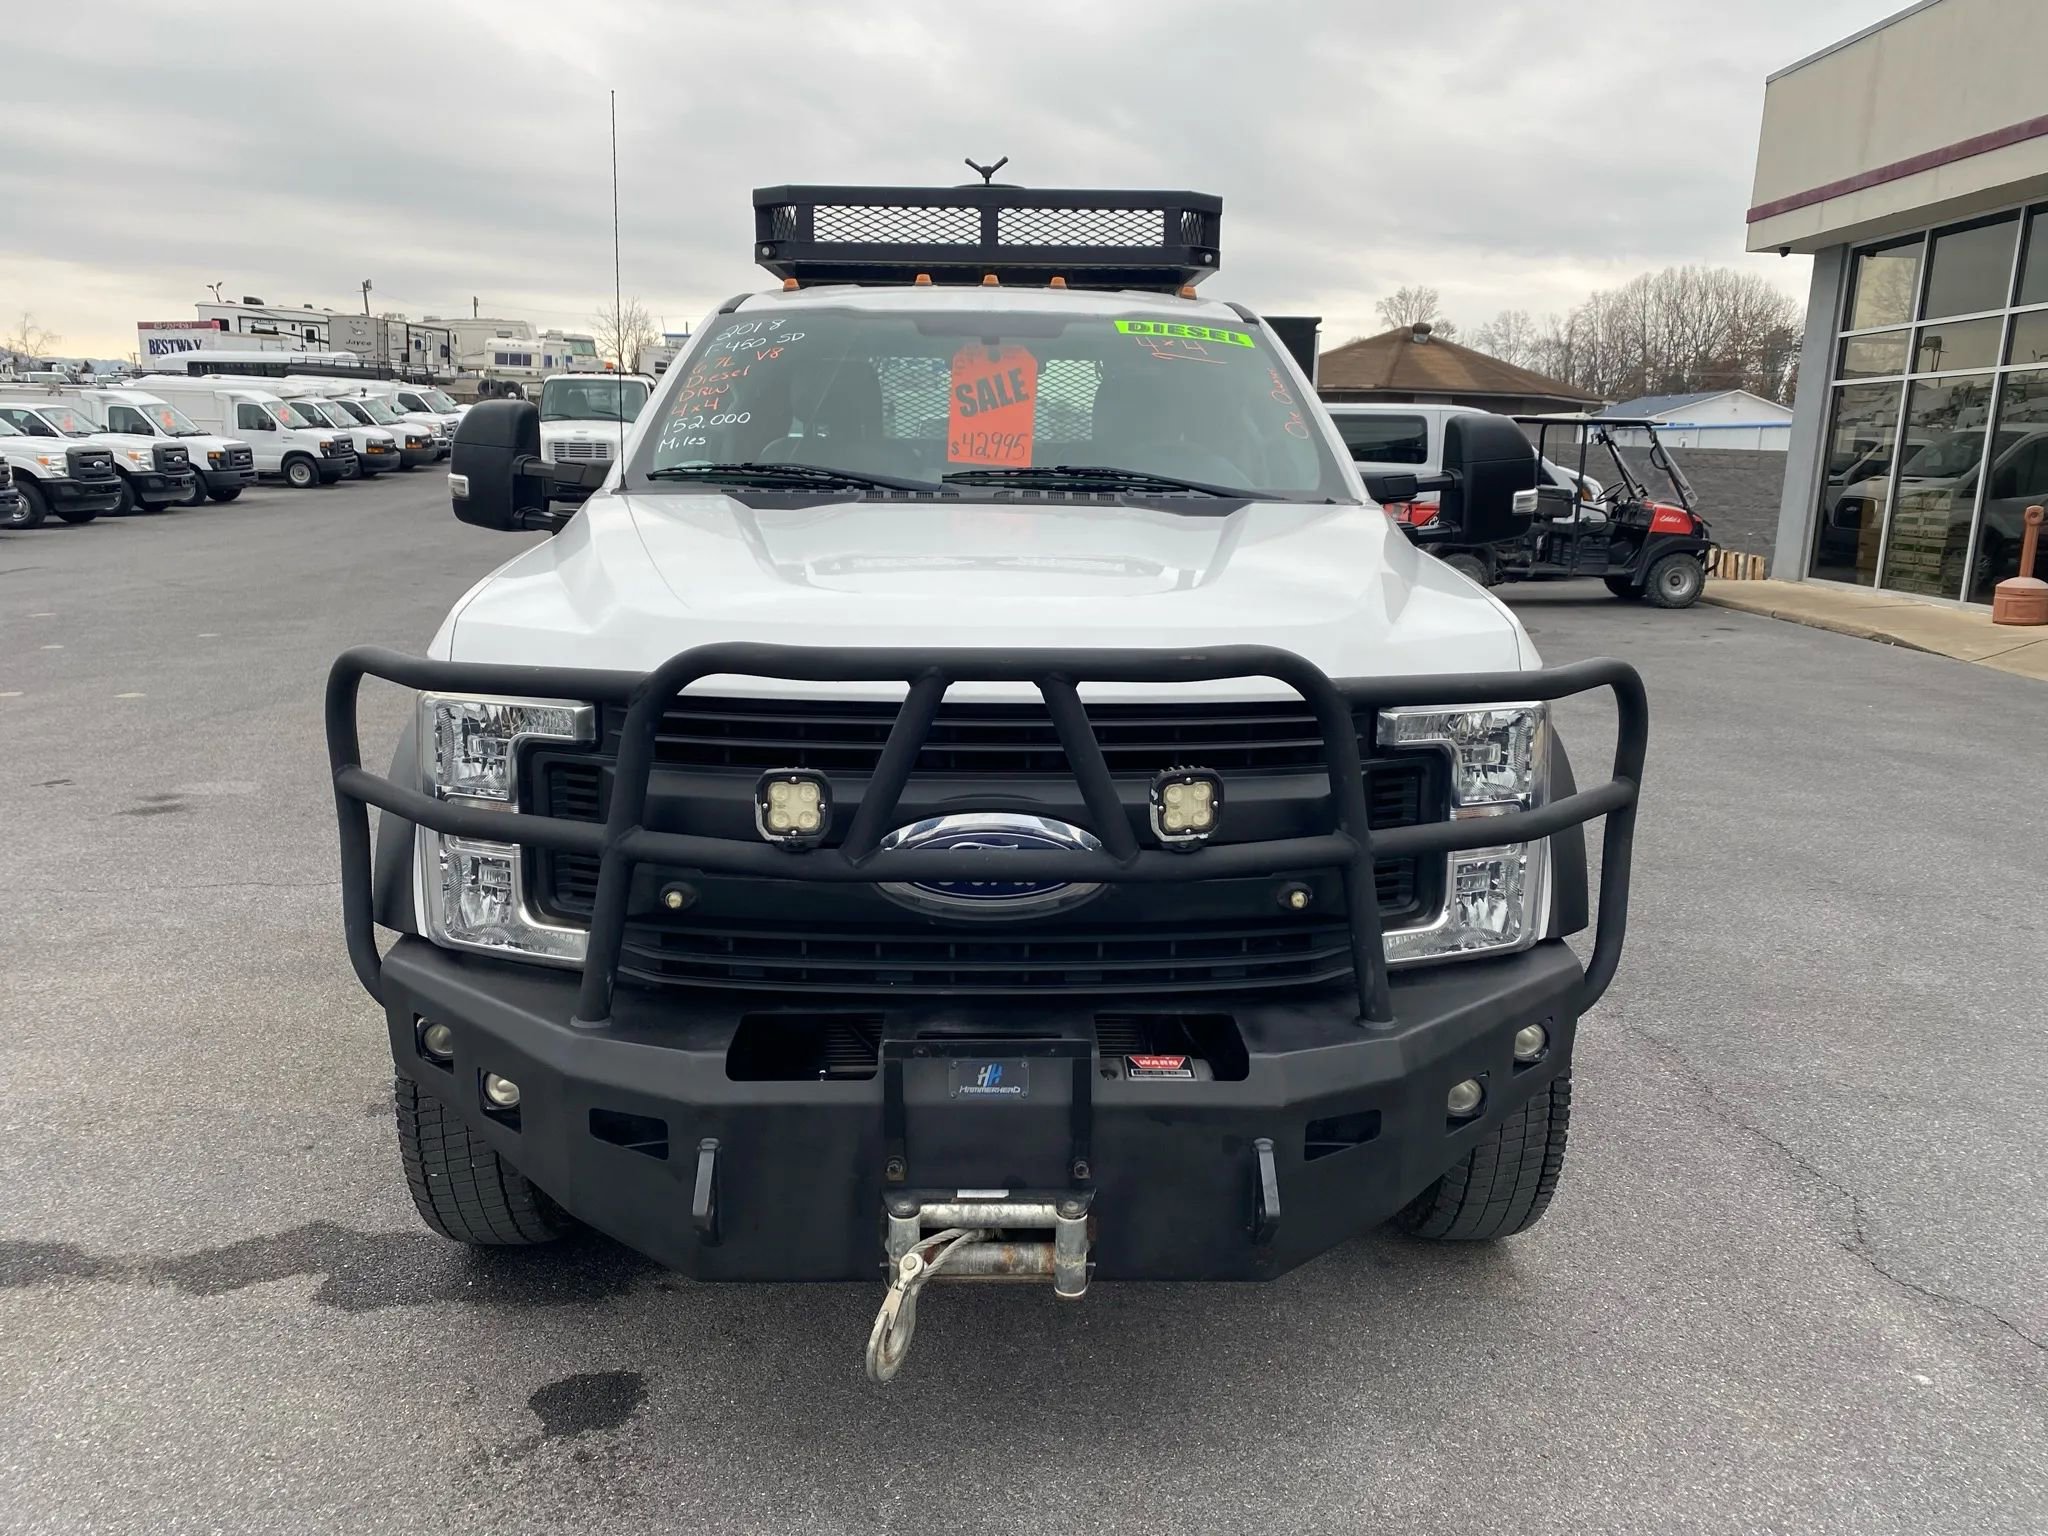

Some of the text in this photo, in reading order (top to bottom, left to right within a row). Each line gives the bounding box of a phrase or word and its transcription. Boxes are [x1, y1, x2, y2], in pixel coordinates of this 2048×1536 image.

[717, 319, 786, 341] 2018
[776, 332, 805, 344] SD
[1128, 322, 1245, 344] DIESEL
[346, 339, 372, 347] Jayco
[757, 347, 784, 361] V8
[686, 364, 750, 388] Diesel
[955, 368, 1030, 417] SALE
[658, 436, 706, 452] Miles
